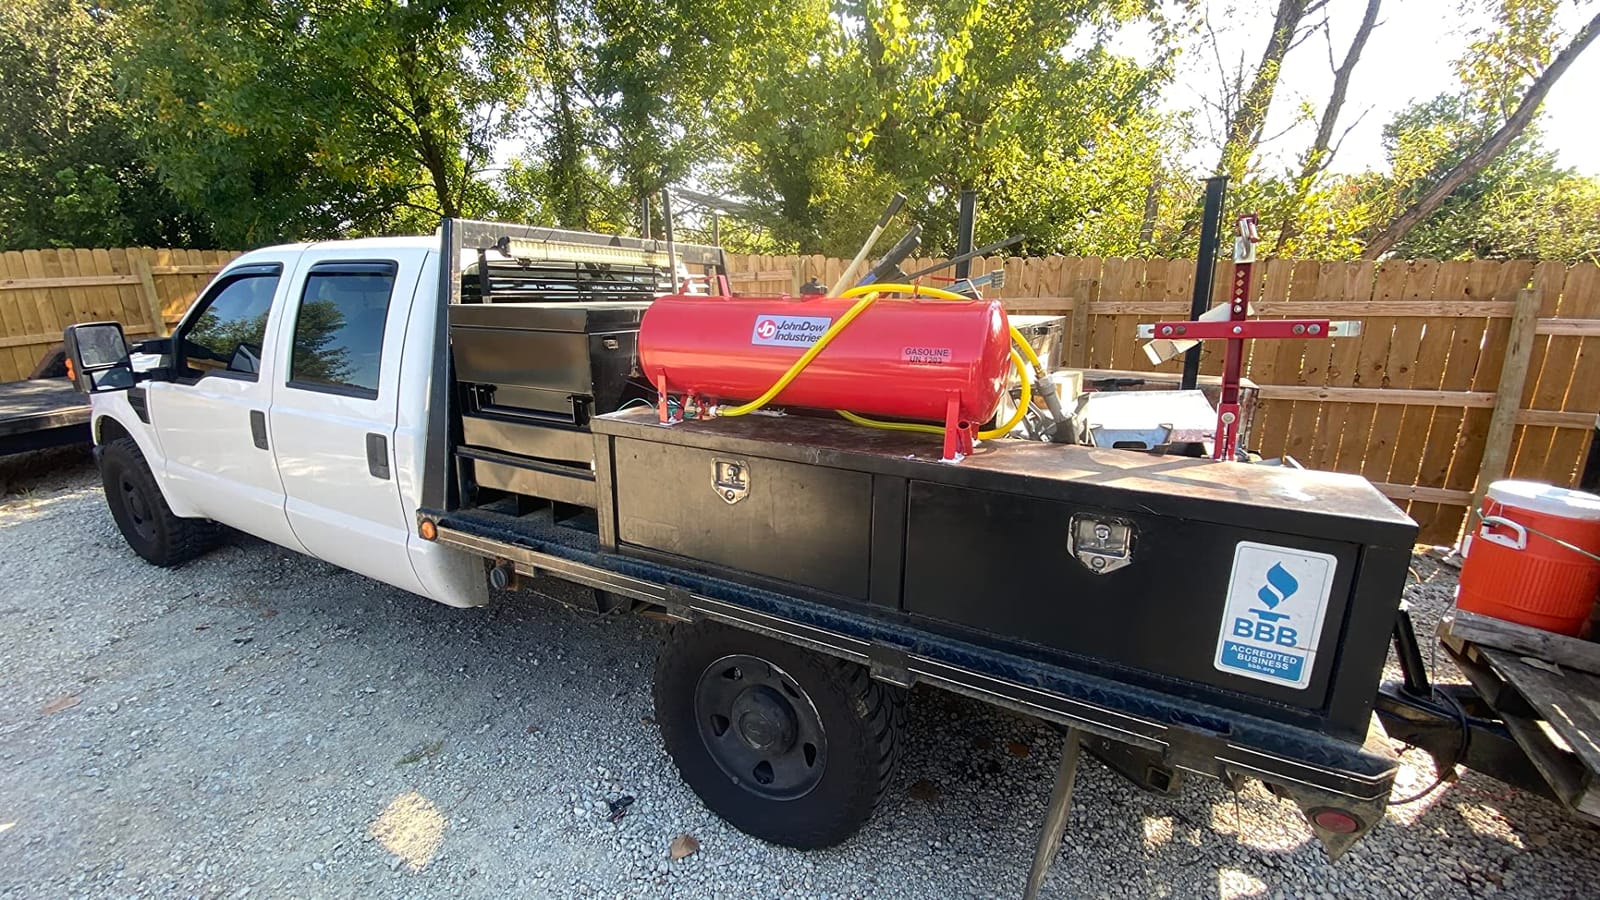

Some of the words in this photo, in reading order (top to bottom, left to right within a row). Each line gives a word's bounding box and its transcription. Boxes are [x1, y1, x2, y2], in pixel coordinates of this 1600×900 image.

[777, 320, 825, 331] JohnDow
[905, 347, 949, 357] GASOLINE
[1233, 617, 1297, 647] BBB
[1230, 644, 1297, 665] ACCREDITED
[1237, 653, 1289, 670] BUSINESS
[1248, 663, 1275, 674] bbb.org
